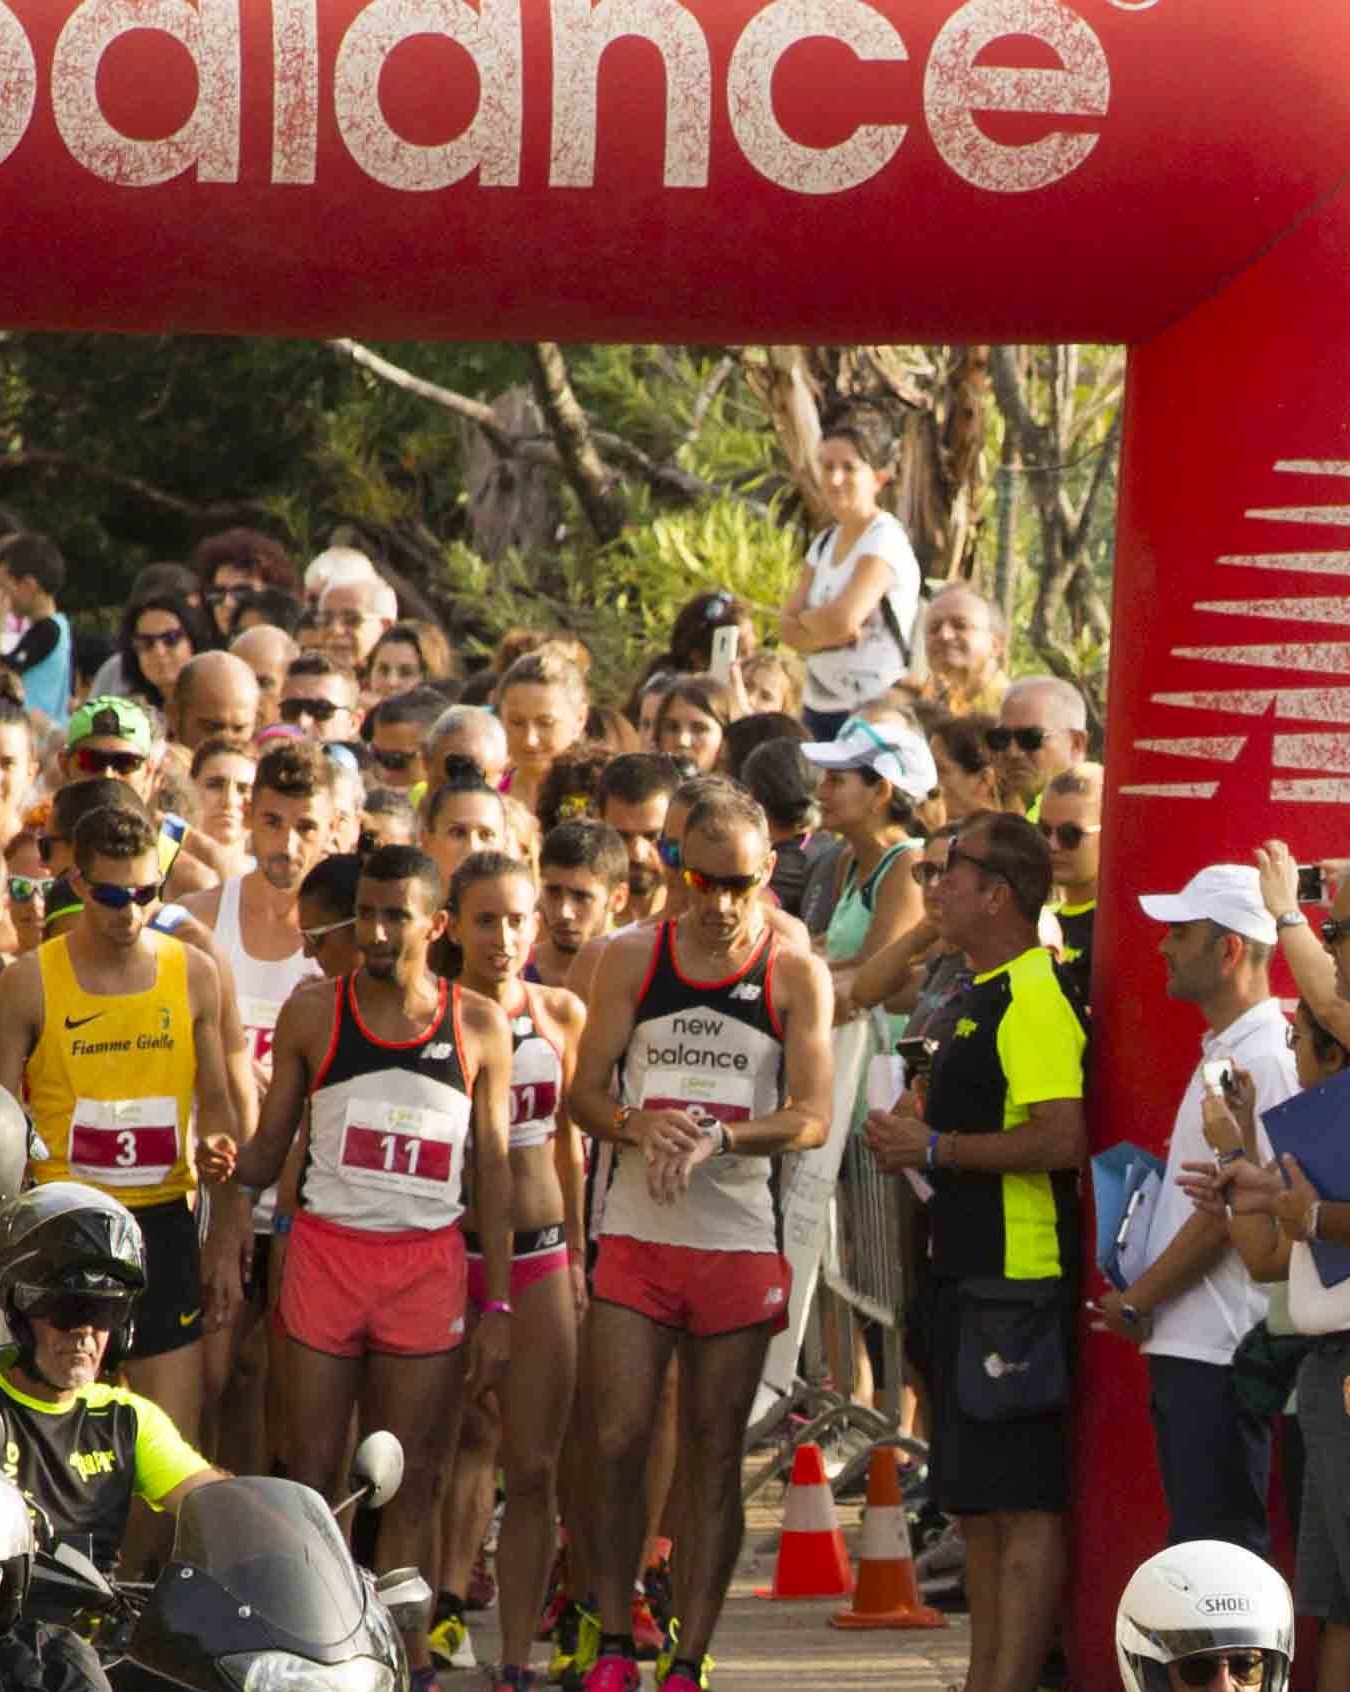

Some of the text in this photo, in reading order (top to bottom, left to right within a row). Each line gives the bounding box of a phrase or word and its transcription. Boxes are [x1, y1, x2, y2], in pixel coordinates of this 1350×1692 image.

[672, 1017, 723, 1037] new
[71, 1034, 174, 1057] Fiamme Gialle
[647, 1043, 748, 1070] balance
[115, 1130, 138, 1166] 3
[380, 1134, 422, 1175] 11
